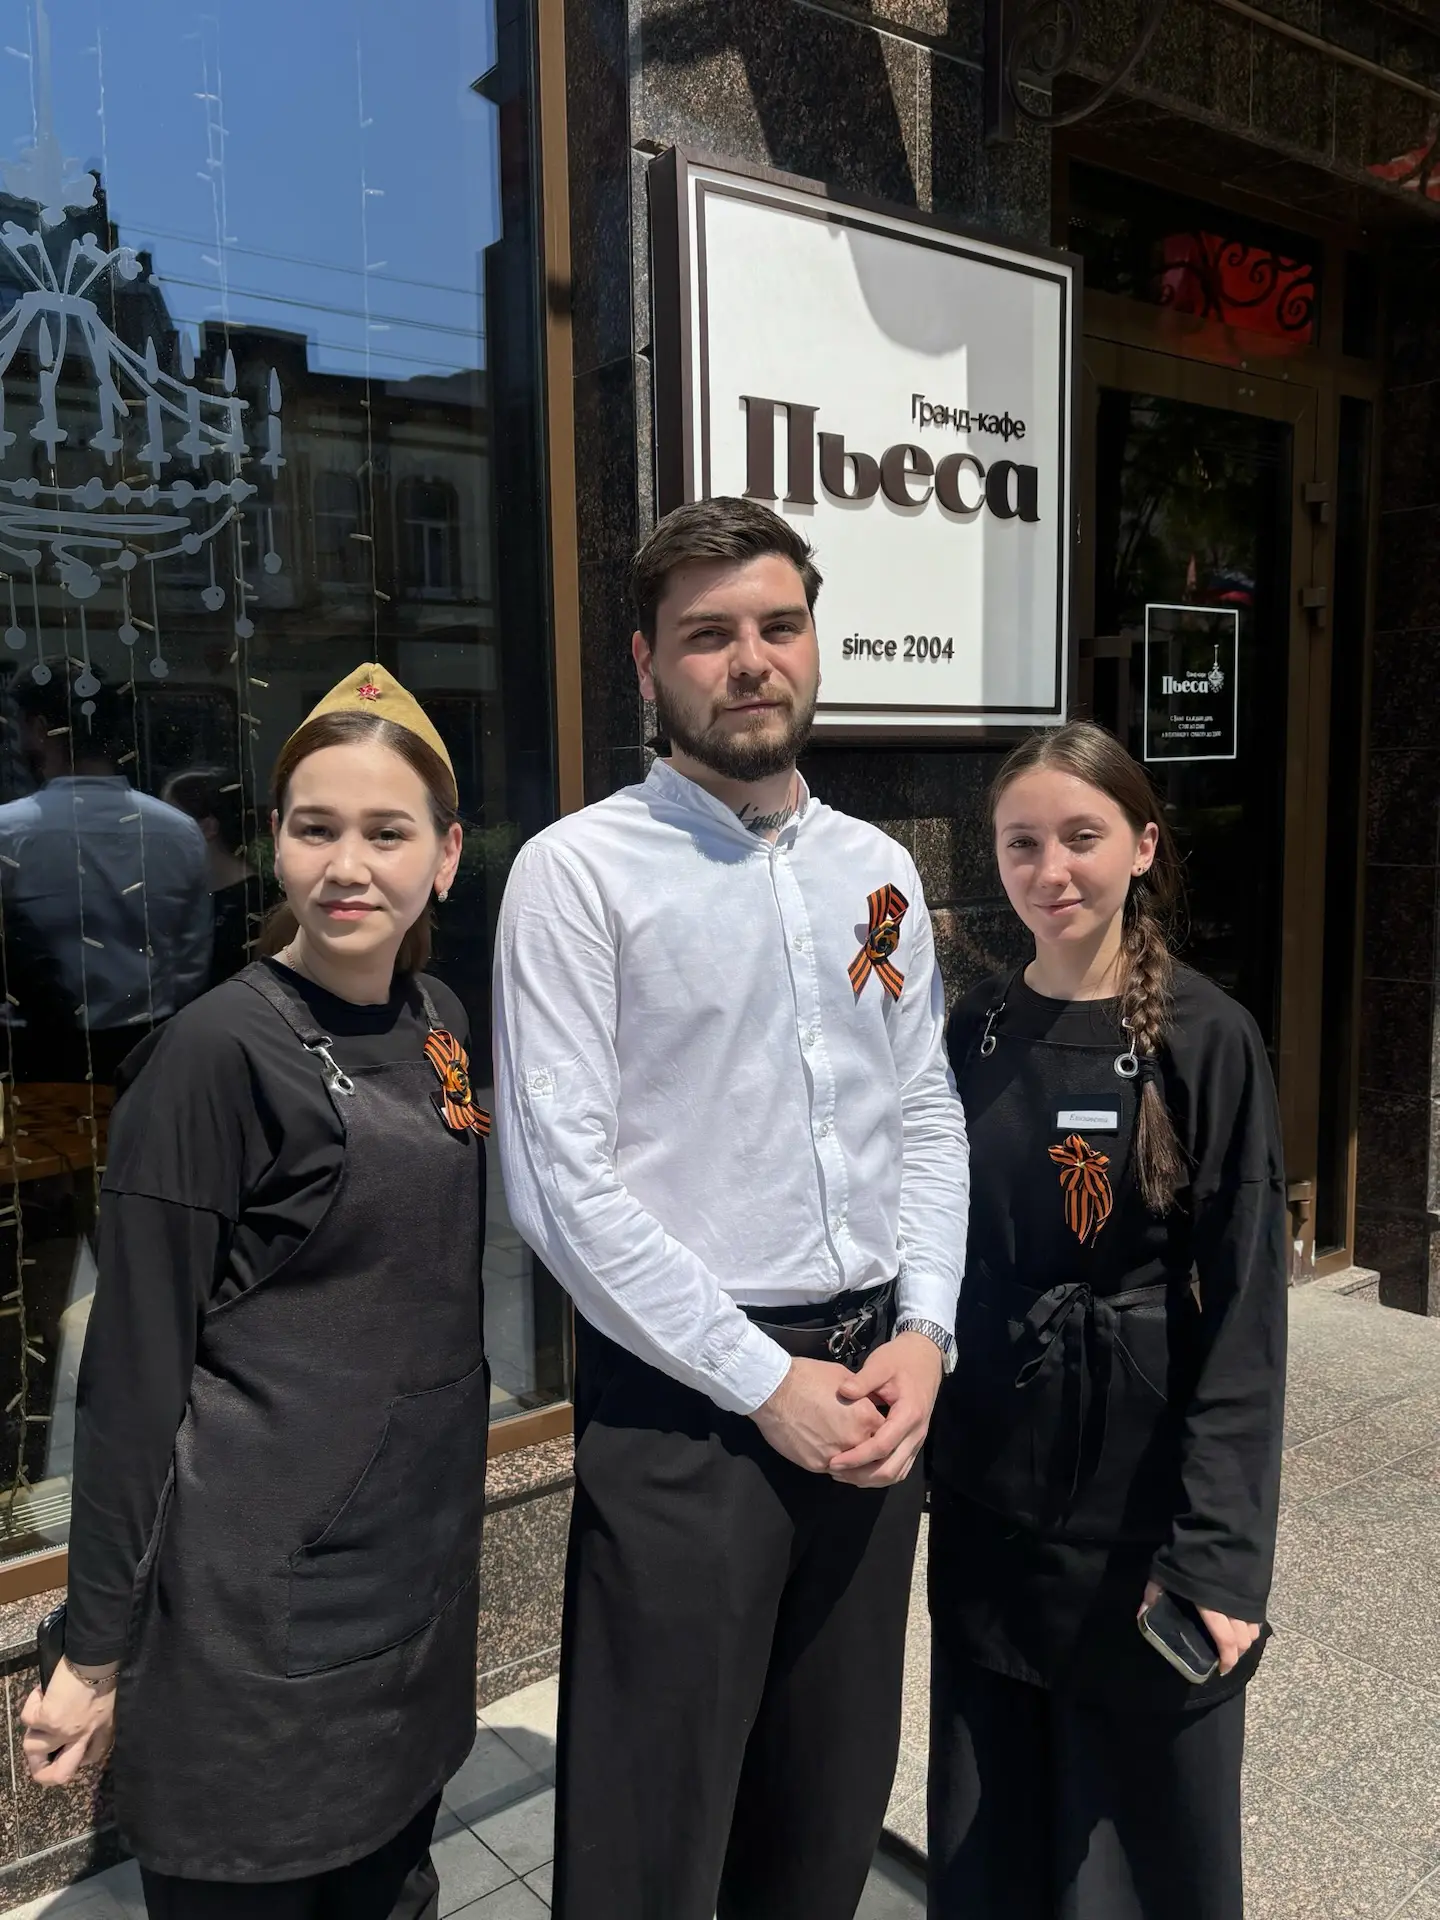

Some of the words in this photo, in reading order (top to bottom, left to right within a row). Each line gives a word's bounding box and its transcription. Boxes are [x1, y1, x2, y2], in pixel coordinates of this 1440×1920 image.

[911, 393, 1027, 442] Гранд-кафе
[739, 395, 1041, 523] Пьеса
[842, 633, 898, 660] since
[903, 634, 955, 662] 2004
[1161, 675, 1209, 695] Пьеса
